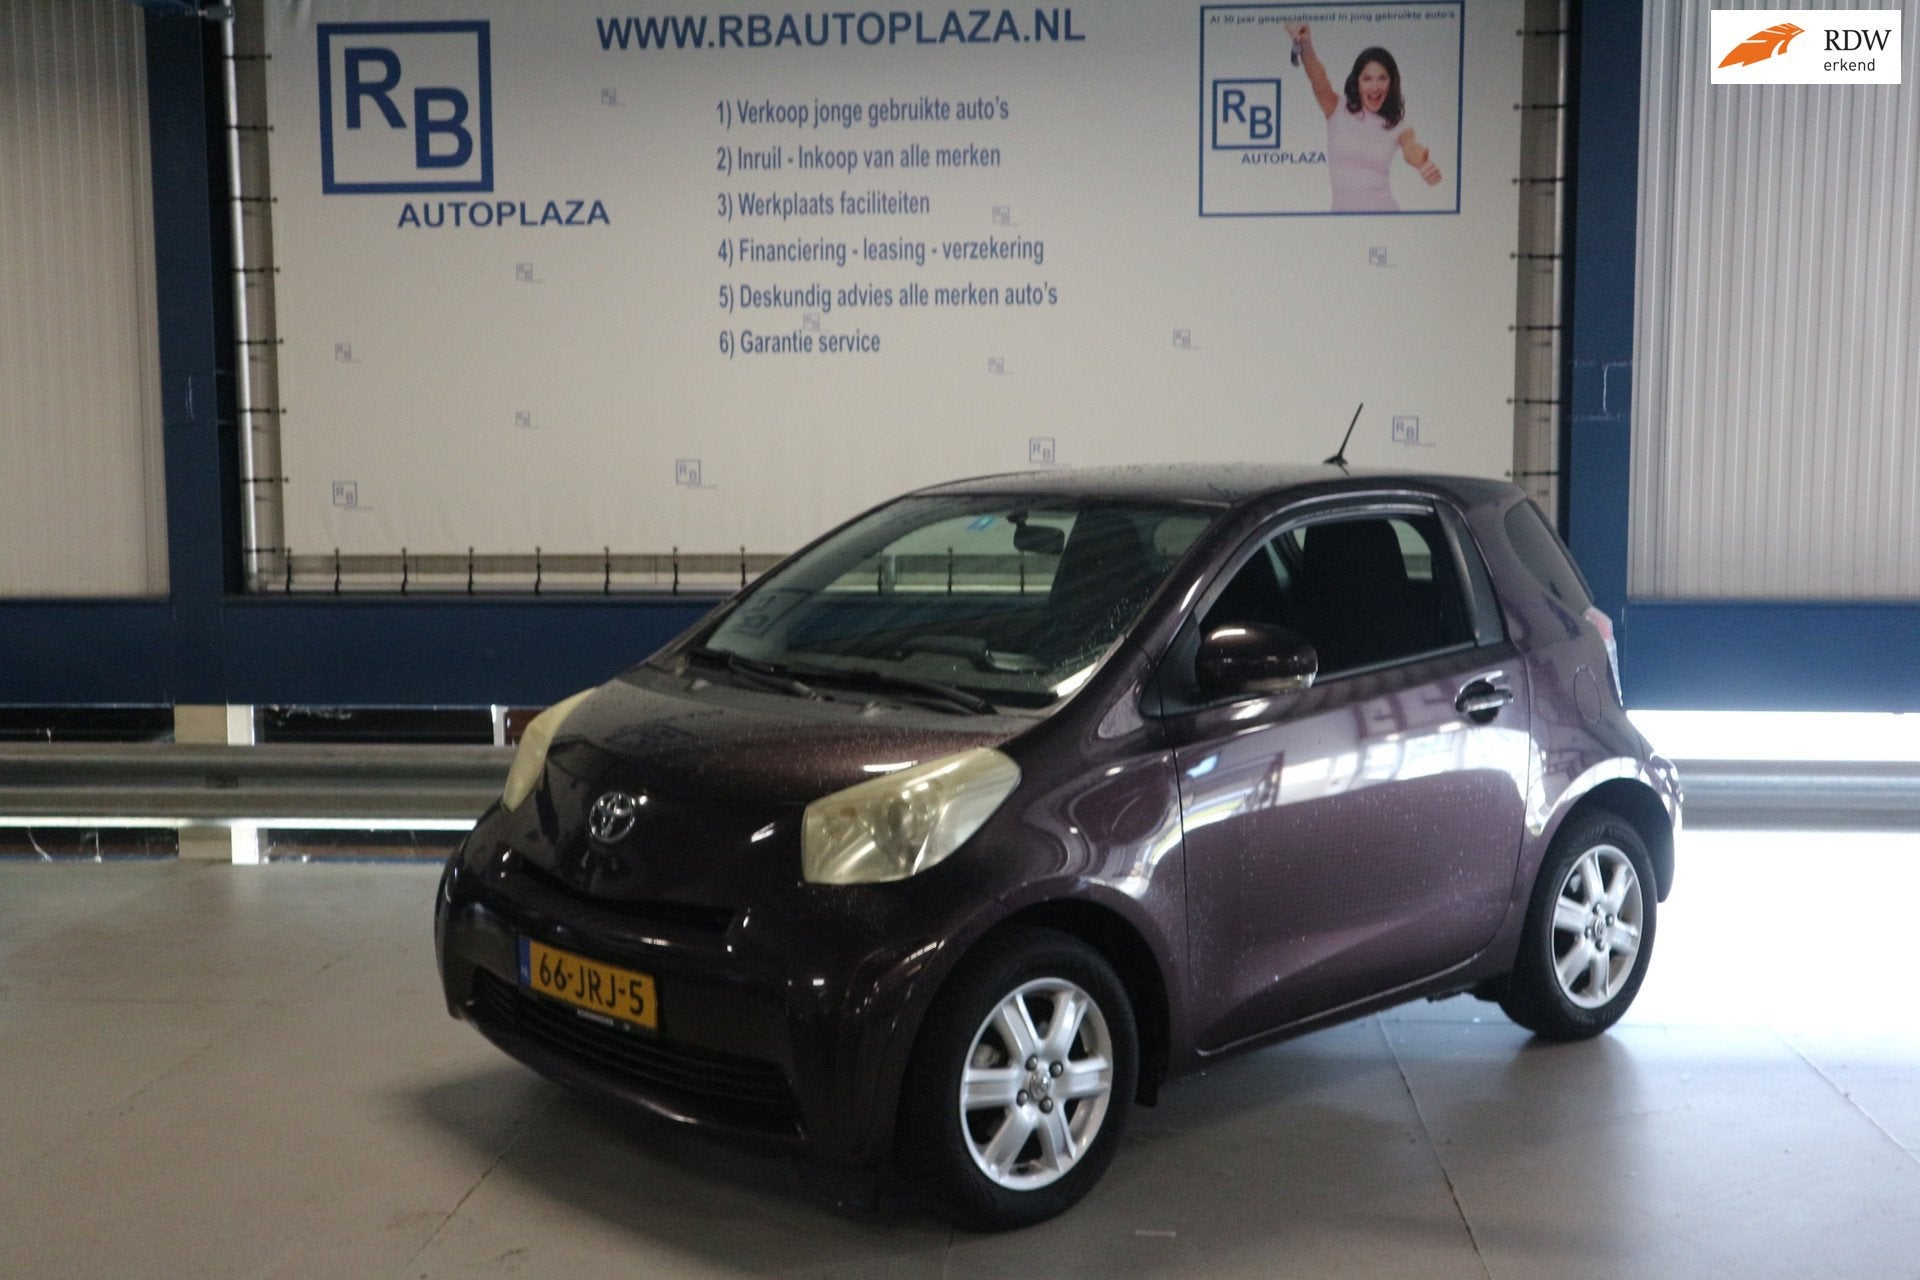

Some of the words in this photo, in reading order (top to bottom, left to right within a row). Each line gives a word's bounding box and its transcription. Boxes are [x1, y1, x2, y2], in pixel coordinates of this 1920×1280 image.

[596, 8, 1086, 50] WWW.RBAUTOPLAZA.NL
[1375, 10, 1422, 22] gebruikte
[717, 100, 731, 129] 1)
[737, 99, 809, 128] Verkoop
[813, 99, 863, 128] jonge
[868, 97, 951, 128] gebruikte
[956, 96, 1010, 121] auto's
[717, 146, 732, 176] 2)
[738, 145, 782, 171] Inruil
[799, 145, 858, 175] Inkoop
[864, 150, 895, 169] van
[900, 143, 930, 168] alle
[936, 143, 1001, 168] merken
[1241, 151, 1327, 165] AUTOPLAZA
[397, 199, 611, 228] AUTOPLAZA
[718, 192, 733, 222] 3)
[738, 191, 835, 221] Werkplaats
[840, 190, 930, 215] faciliteiten
[718, 238, 733, 268] 4)
[740, 237, 847, 267] Financiering
[864, 236, 926, 266] leasing
[942, 235, 1045, 265] verzekering
[719, 284, 734, 314] 5)
[740, 283, 832, 313] Deskundig
[837, 282, 893, 307] advies
[899, 282, 928, 307] alle
[935, 282, 1000, 306] merken
[1005, 281, 1058, 306] auto's
[719, 330, 735, 359] 6)
[740, 329, 814, 355] Garantie
[819, 328, 881, 354] service
[539, 953, 644, 1016] 66-JRJ-5
